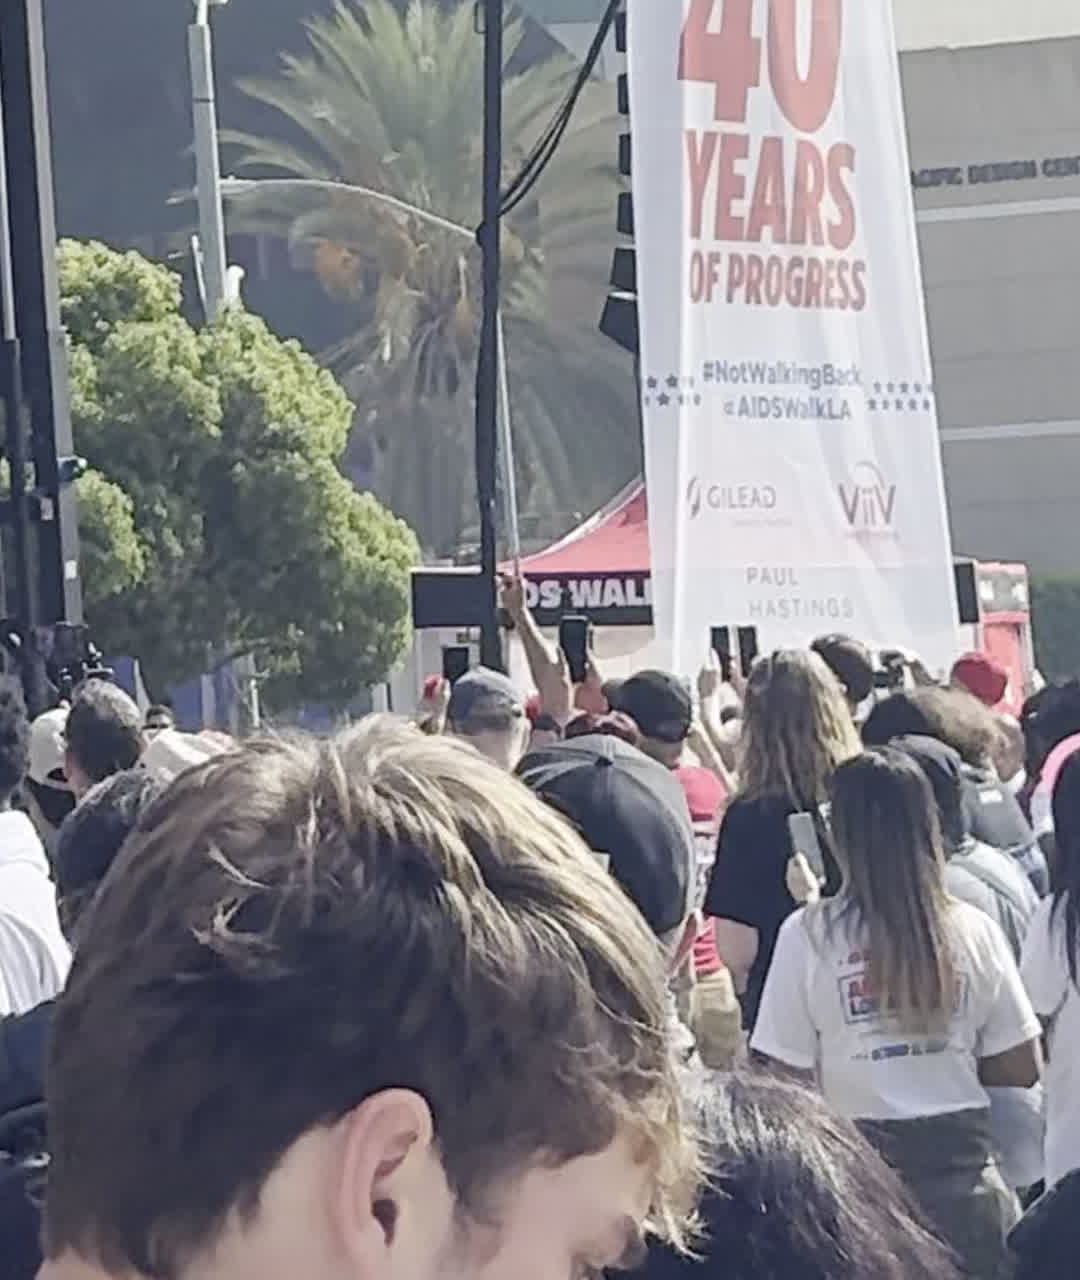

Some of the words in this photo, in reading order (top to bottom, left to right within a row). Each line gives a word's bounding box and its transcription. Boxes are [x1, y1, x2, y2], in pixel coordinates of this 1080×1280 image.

[685, 129, 857, 251] YEARS
[690, 250, 721, 304] OF
[726, 252, 867, 312] PROGRESS
[703, 360, 861, 390] #NotWalkingBack
[707, 485, 777, 510] GILEAD
[746, 567, 799, 586] PAUL
[749, 598, 854, 618] HASTINGS
